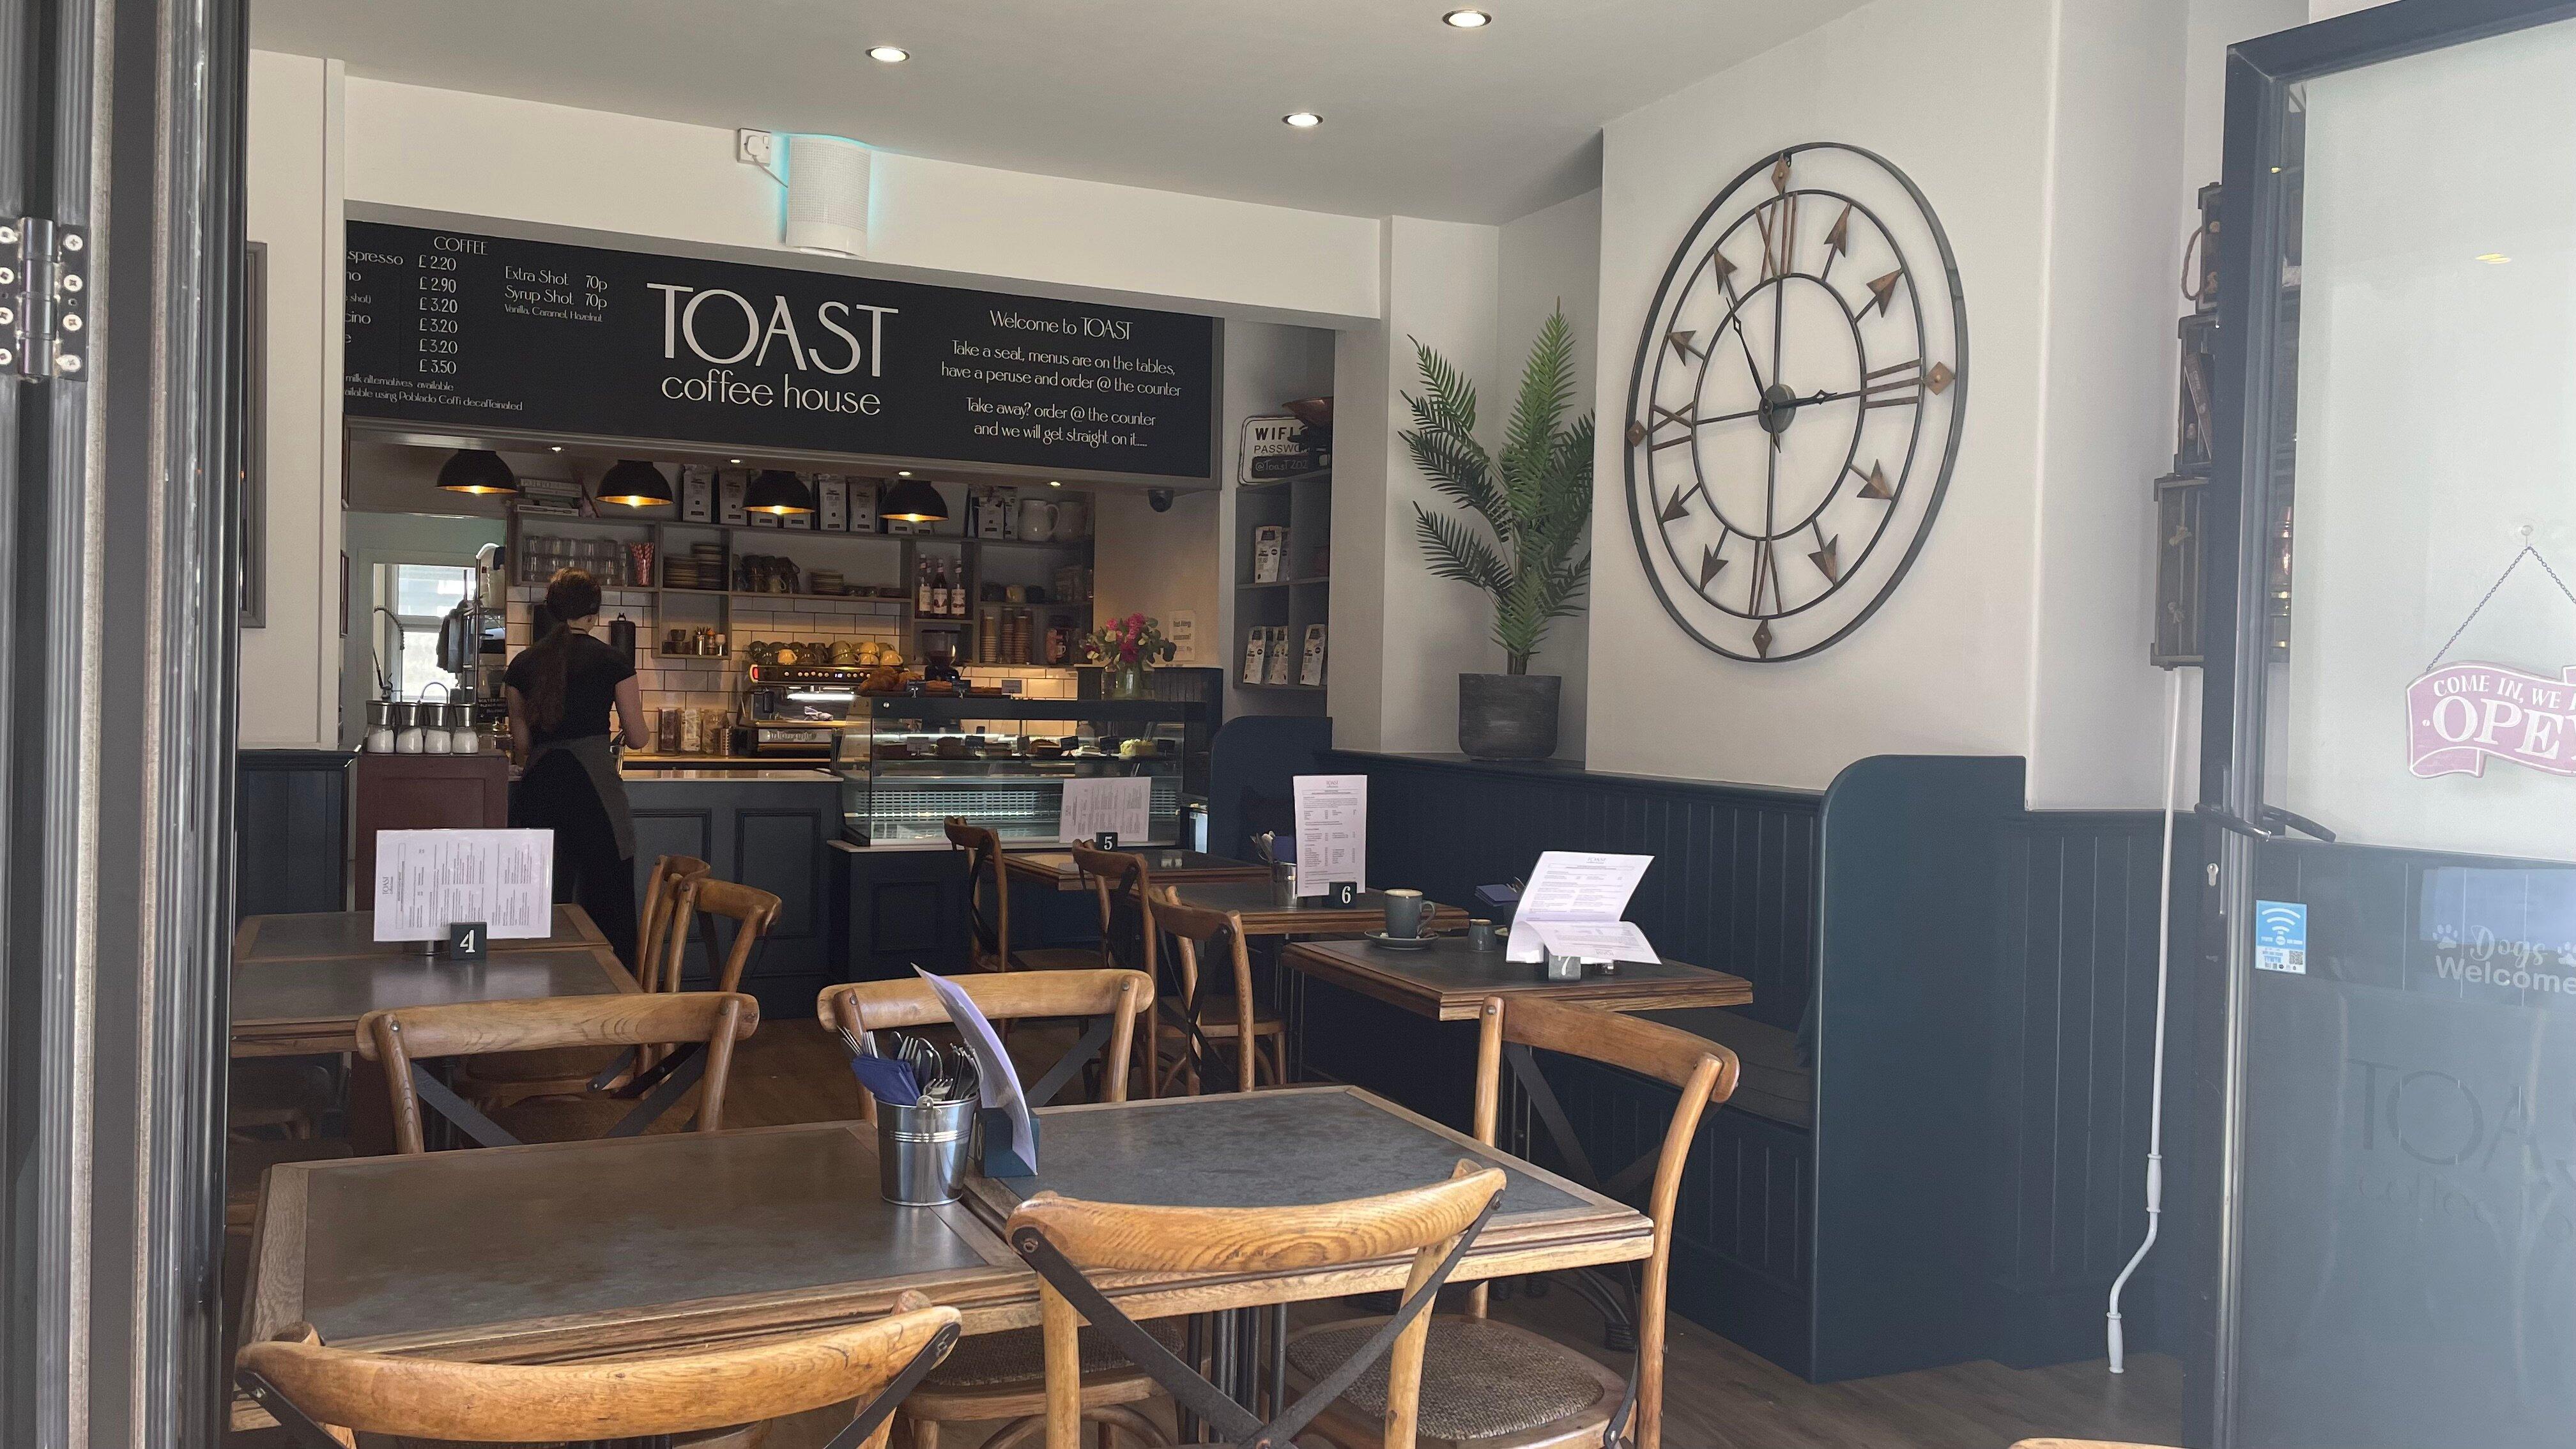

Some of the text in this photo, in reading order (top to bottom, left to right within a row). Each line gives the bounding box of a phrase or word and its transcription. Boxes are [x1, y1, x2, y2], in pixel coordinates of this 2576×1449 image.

[434, 236, 488, 256] COFFEE
[505, 266, 608, 293] Extra Shot 70p
[505, 284, 608, 311] Syrup Shot 70p
[570, 310, 603, 323] Hazelnut
[647, 282, 899, 377] TOAST
[990, 309, 1133, 341] Welcome to TOAST
[952, 339, 1176, 376] Take a seat, menus are on the tables,
[345, 373, 454, 392] milk alternatives available
[661, 368, 881, 415] coffee house
[941, 361, 1181, 397] have a peruse and order @ the counter
[375, 391, 397, 403] using
[399, 391, 437, 404] Poblado
[438, 395, 462, 406] Coffi
[463, 397, 523, 411] decaffeinated
[966, 396, 1156, 426] Take away? order @ the counter
[974, 422, 998, 436] and
[1001, 427, 1020, 438] we
[1023, 424, 1041, 439] will
[1044, 426, 1064, 445] get
[1066, 427, 1108, 448] straight
[1111, 434, 1128, 445] on
[2434, 675, 2490, 696] COME
[2497, 677, 2523, 703] IN,
[2532, 687, 2561, 709] WE
[2433, 695, 2576, 760] OPE
[1103, 836, 1113, 850] 5
[1342, 885, 1351, 904] 6
[459, 930, 475, 953] 4
[2470, 925, 2548, 968] Dogs
[2435, 955, 2576, 995] Welcome
